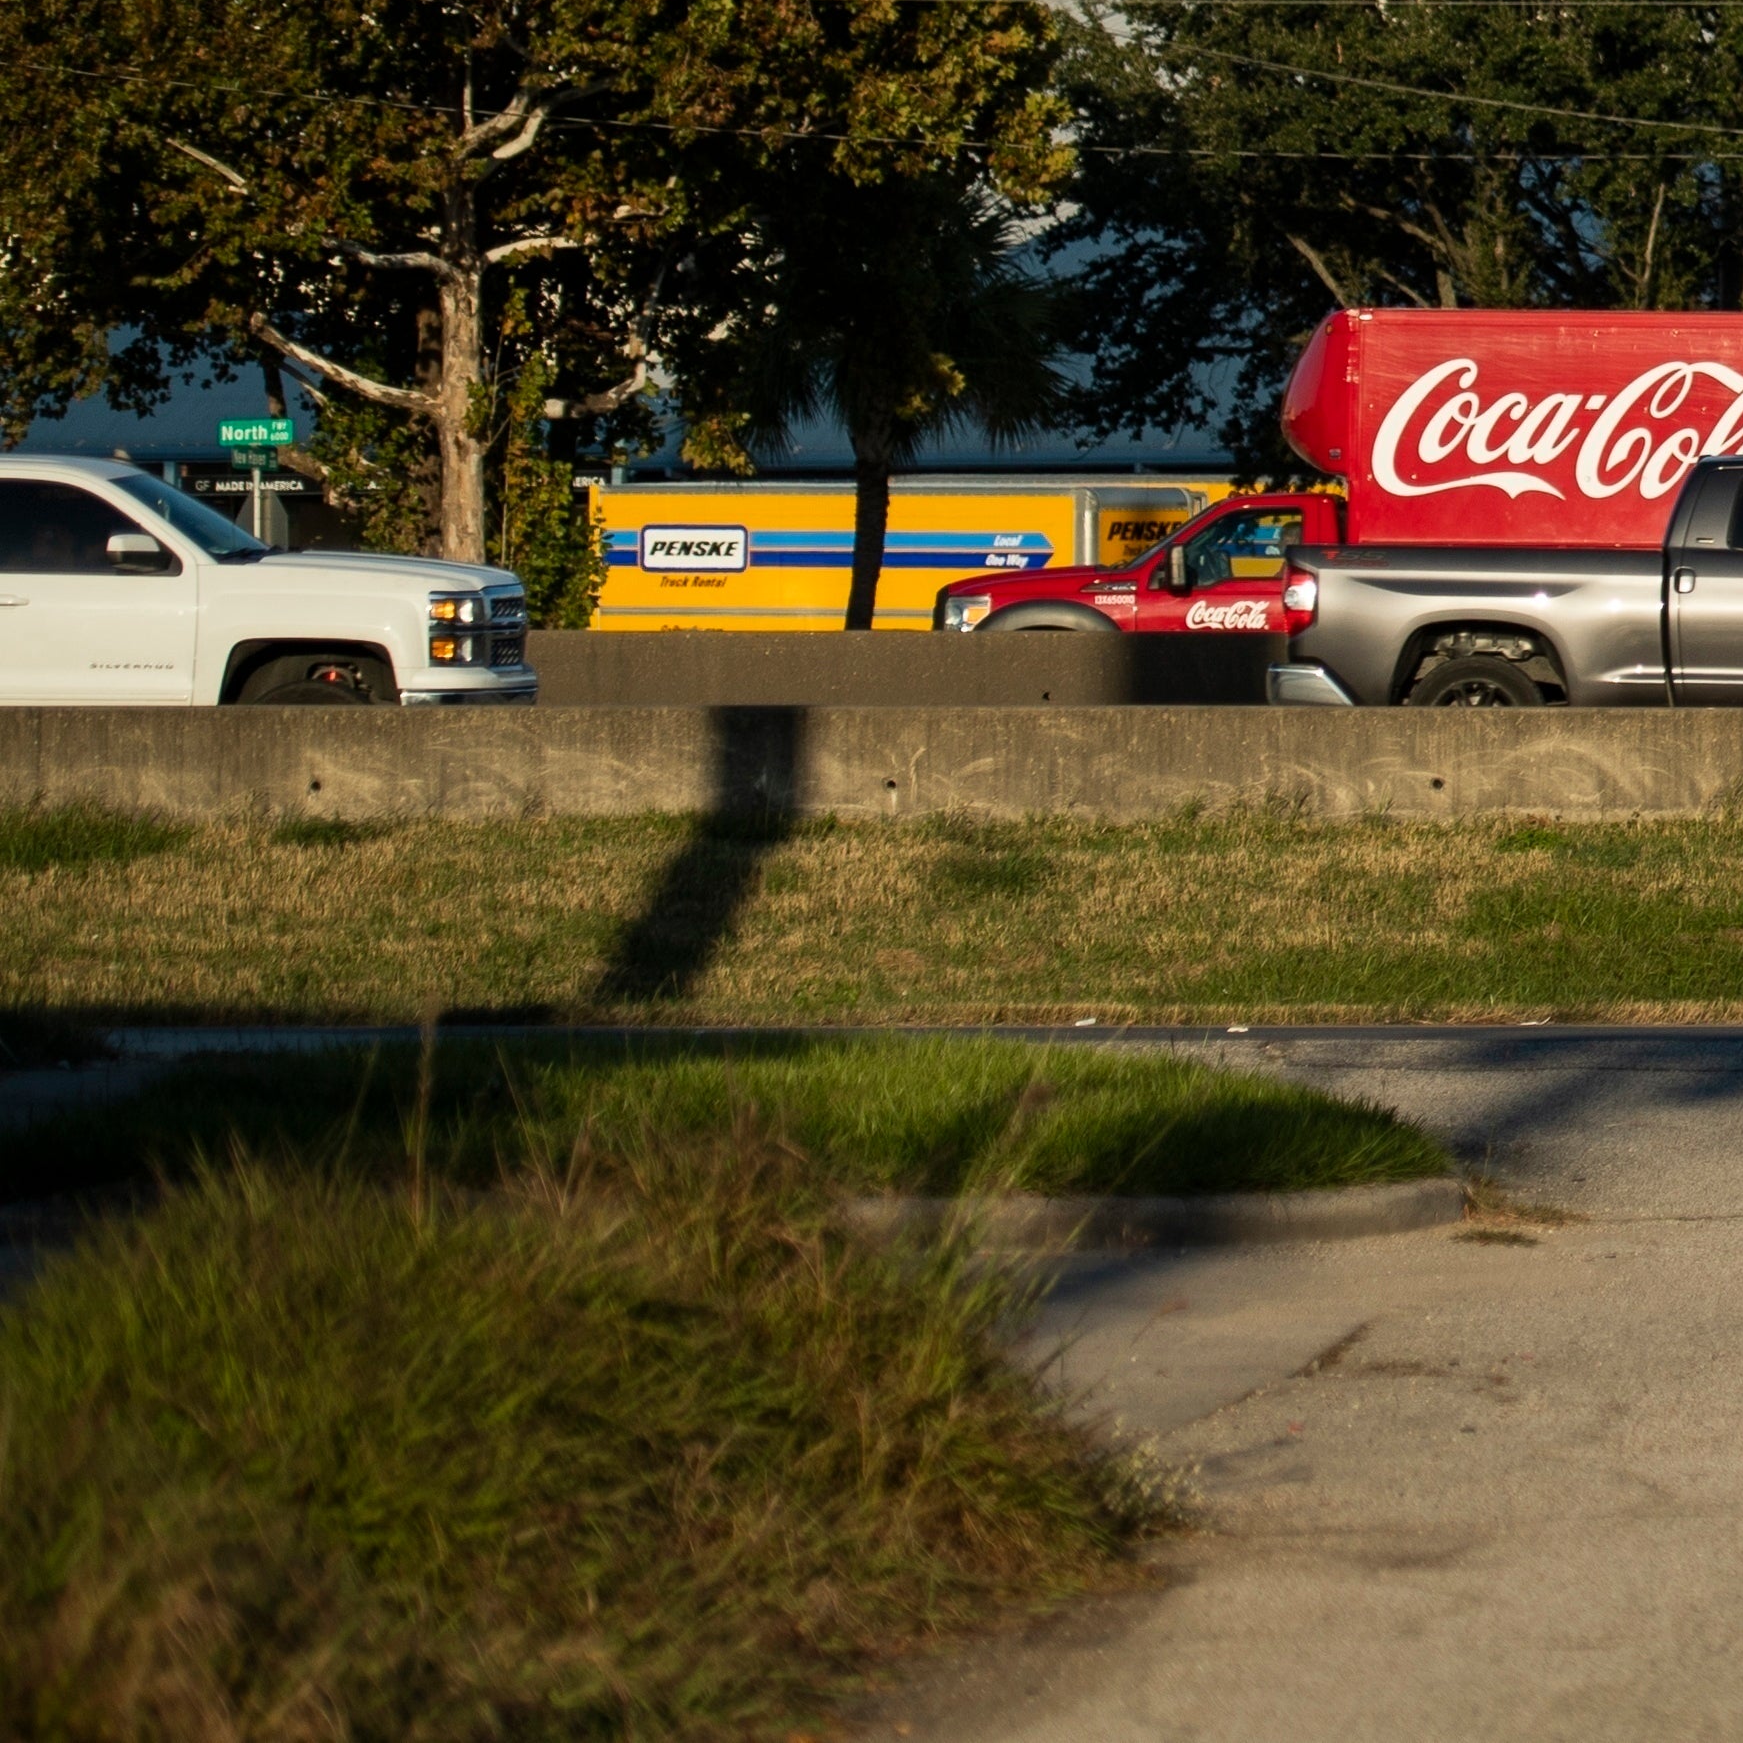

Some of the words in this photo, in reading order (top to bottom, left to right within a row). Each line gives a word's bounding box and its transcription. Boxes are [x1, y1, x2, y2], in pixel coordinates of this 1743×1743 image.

[221, 425, 268, 442] North
[215, 481, 245, 492] MADE
[650, 541, 739, 556] PENSKE
[660, 575, 689, 588] Truck
[691, 575, 728, 588] Rental
